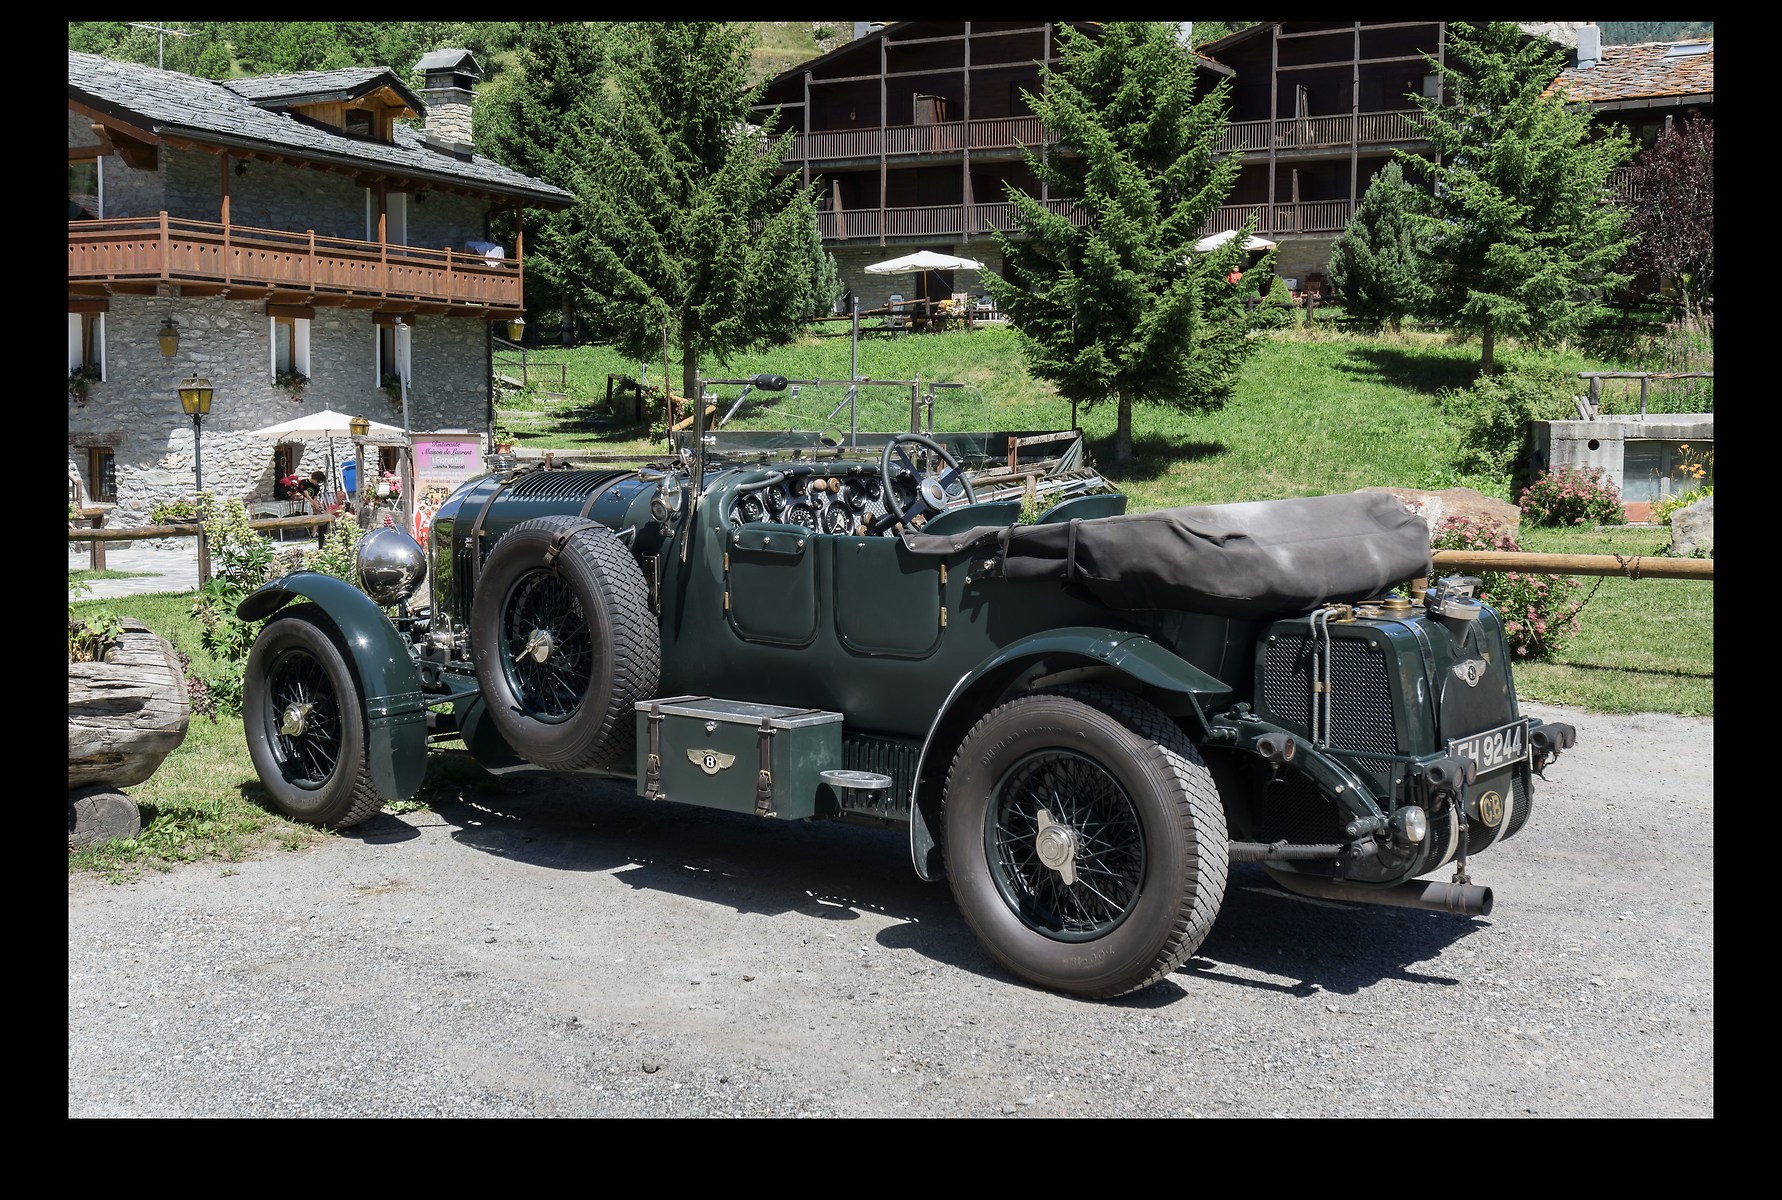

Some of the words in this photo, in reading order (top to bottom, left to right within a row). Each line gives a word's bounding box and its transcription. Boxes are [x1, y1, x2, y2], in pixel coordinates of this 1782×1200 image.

[451, 448, 472, 456] Laurent
[1483, 726, 1522, 767] 9244
[705, 756, 715, 768] B
